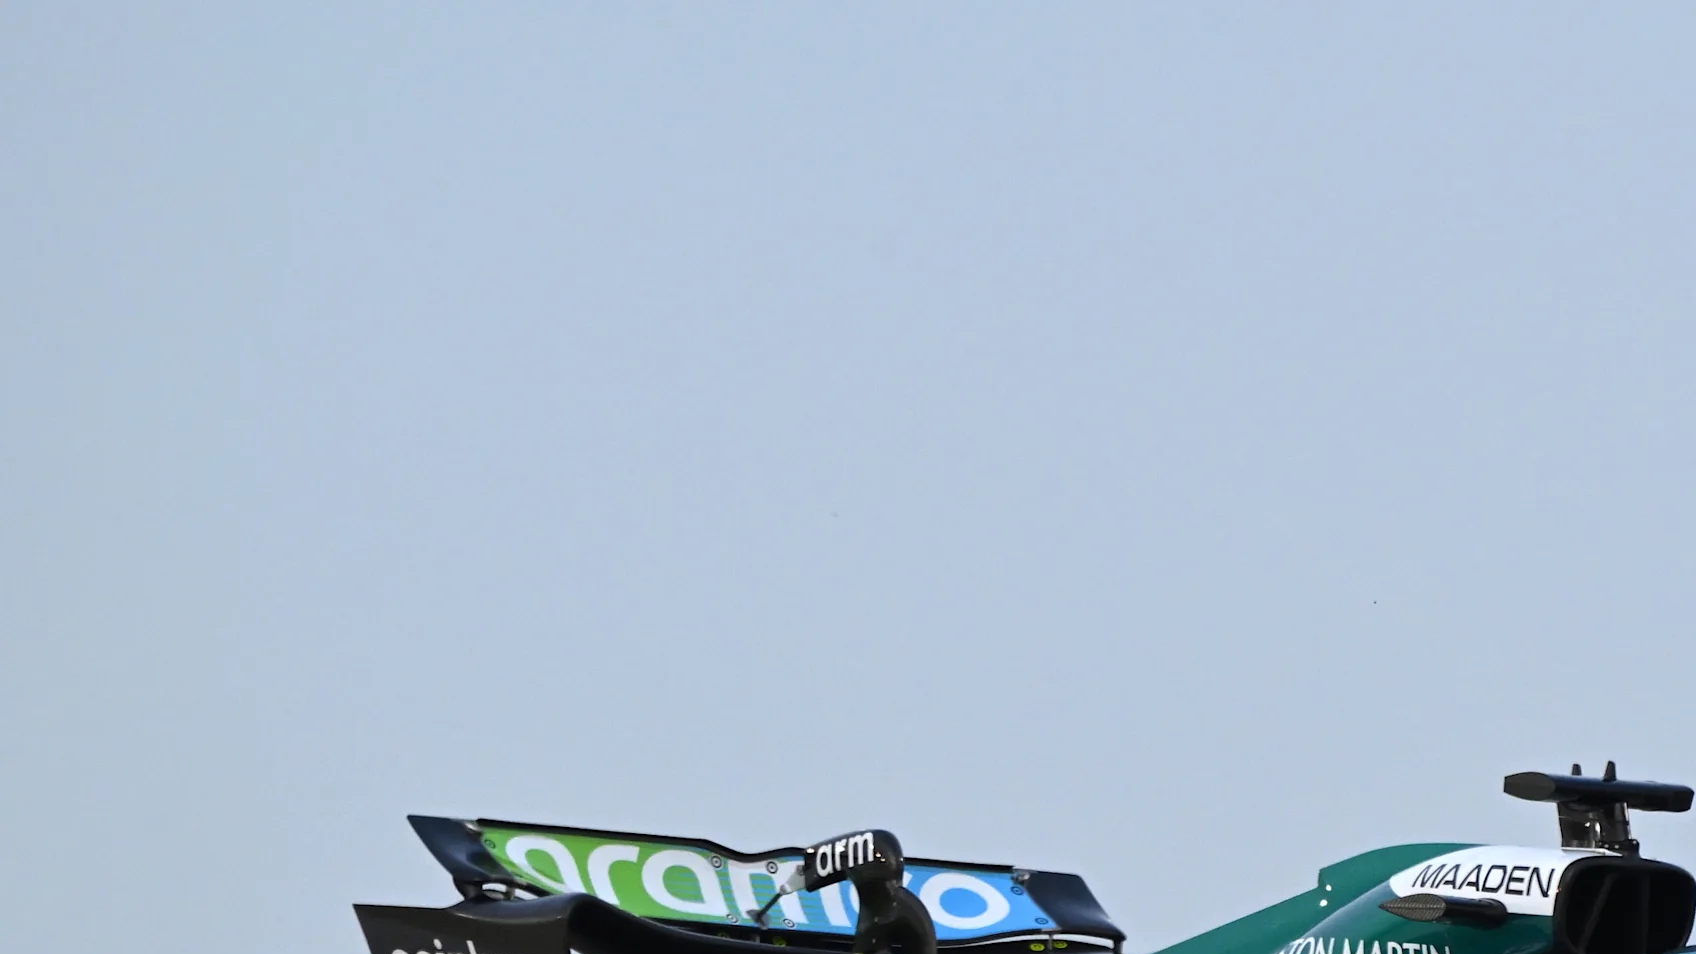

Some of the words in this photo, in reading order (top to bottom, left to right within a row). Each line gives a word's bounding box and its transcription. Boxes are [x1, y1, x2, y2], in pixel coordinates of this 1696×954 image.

[815, 831, 874, 878] arm
[505, 834, 1011, 930] aramo
[1412, 864, 1556, 898] MAADEN
